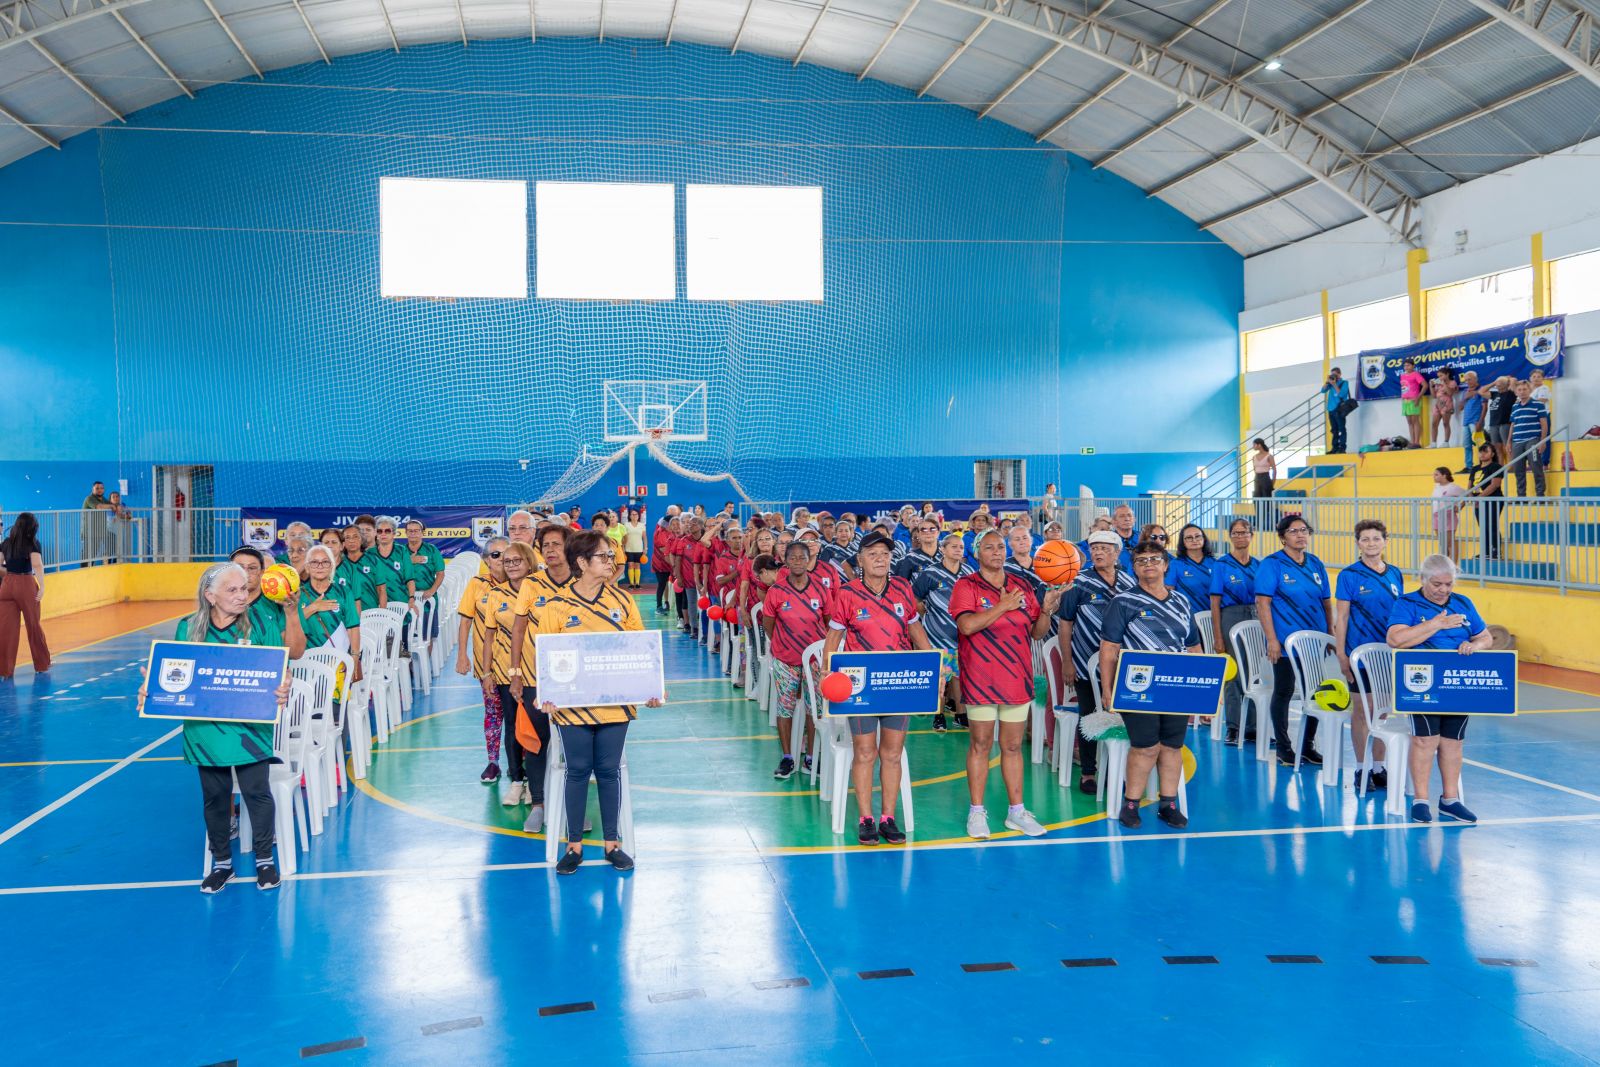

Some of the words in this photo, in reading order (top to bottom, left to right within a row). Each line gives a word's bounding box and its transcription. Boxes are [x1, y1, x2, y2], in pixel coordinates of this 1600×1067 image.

[1386, 358, 1403, 368] OS
[1406, 346, 1467, 365] OVINHOS
[1469, 343, 1487, 355] DA
[1490, 337, 1520, 352] VILA
[1486, 355, 1506, 364] Erse
[332, 515, 359, 526] JIV
[583, 653, 652, 664] GUERREIROS
[584, 661, 655, 671] DESTEMIDOS
[197, 667, 214, 676] OS
[215, 668, 278, 679] NOVINHOS
[870, 669, 917, 679] FURACÃO
[1443, 669, 1499, 678] ALEGRIA
[212, 676, 230, 685] DA
[232, 678, 260, 686] VILA
[870, 677, 930, 686] ESPERANÇA
[1154, 675, 1184, 683] FELIZ
[1185, 676, 1220, 685] IDADE
[1443, 677, 1461, 685] DE
[1463, 678, 1503, 686] VIVER
